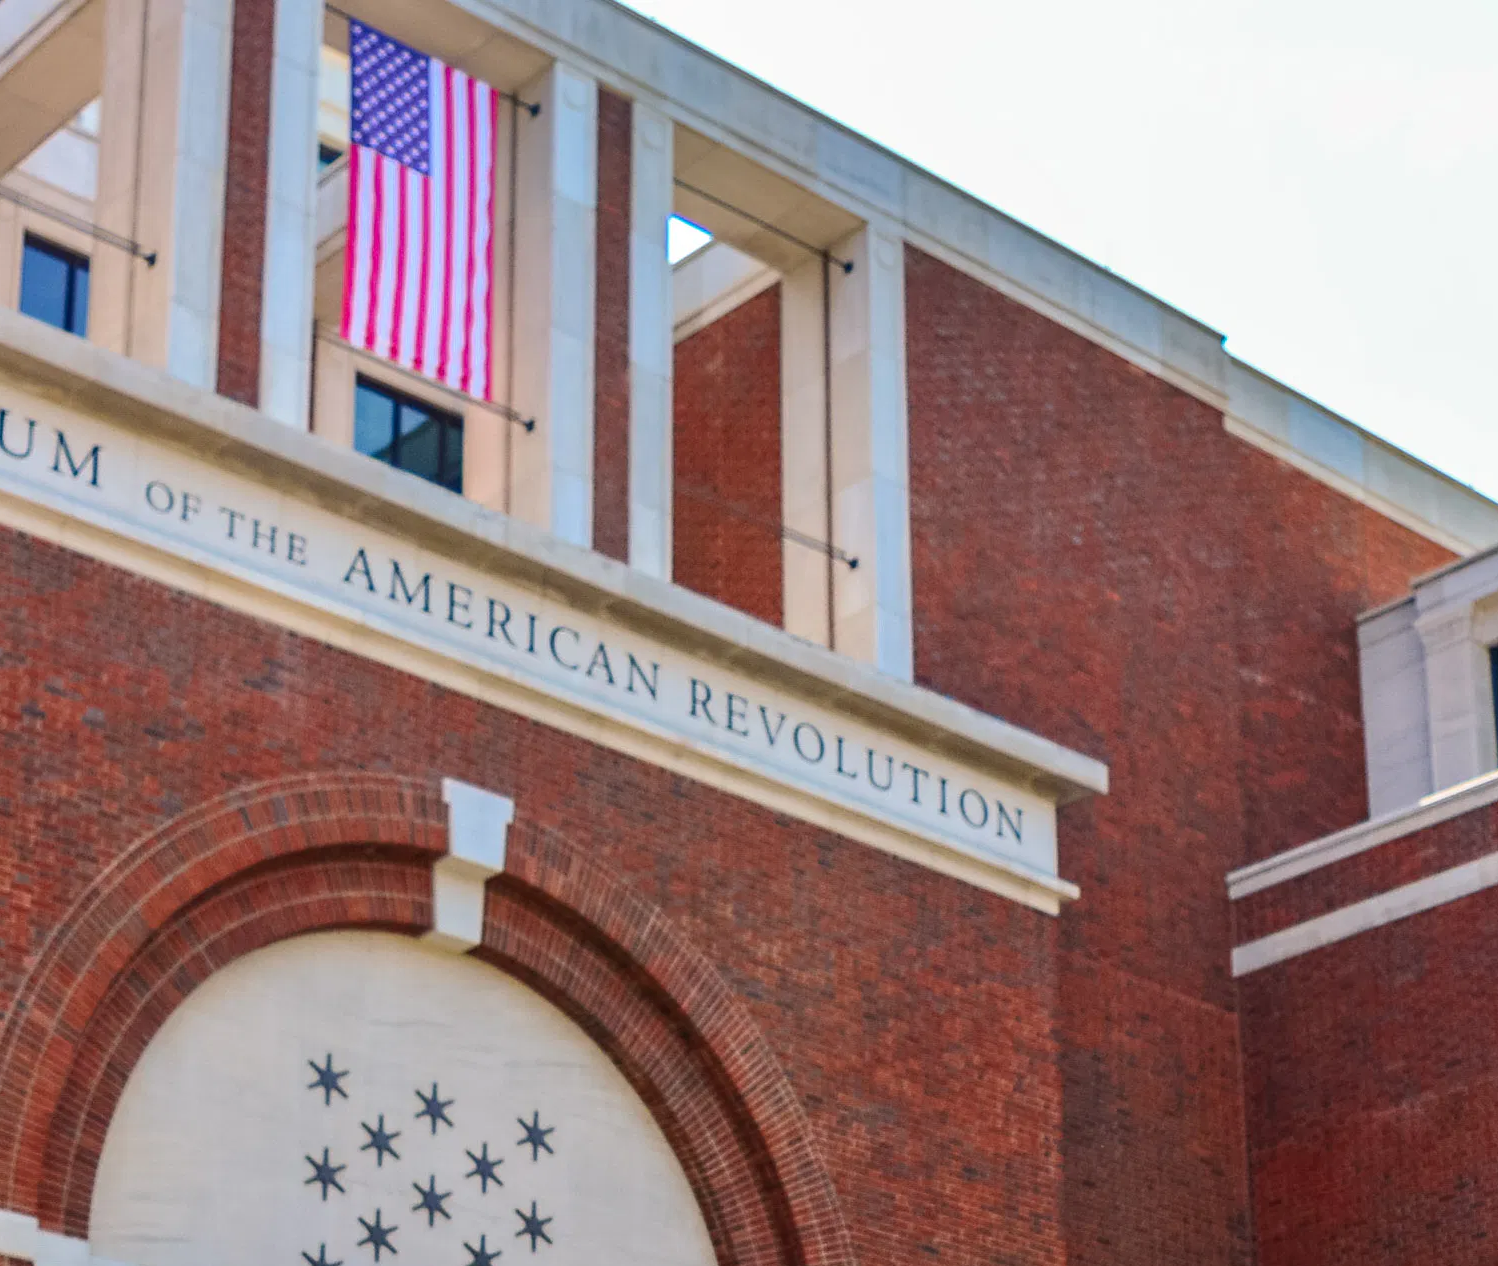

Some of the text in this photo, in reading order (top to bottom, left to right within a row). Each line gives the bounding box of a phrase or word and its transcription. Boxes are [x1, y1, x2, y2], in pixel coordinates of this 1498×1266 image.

[143, 478, 202, 524] OF
[219, 505, 308, 567] THE
[342, 546, 661, 702] AMERICAN
[689, 676, 1027, 846] REVOLUTION
